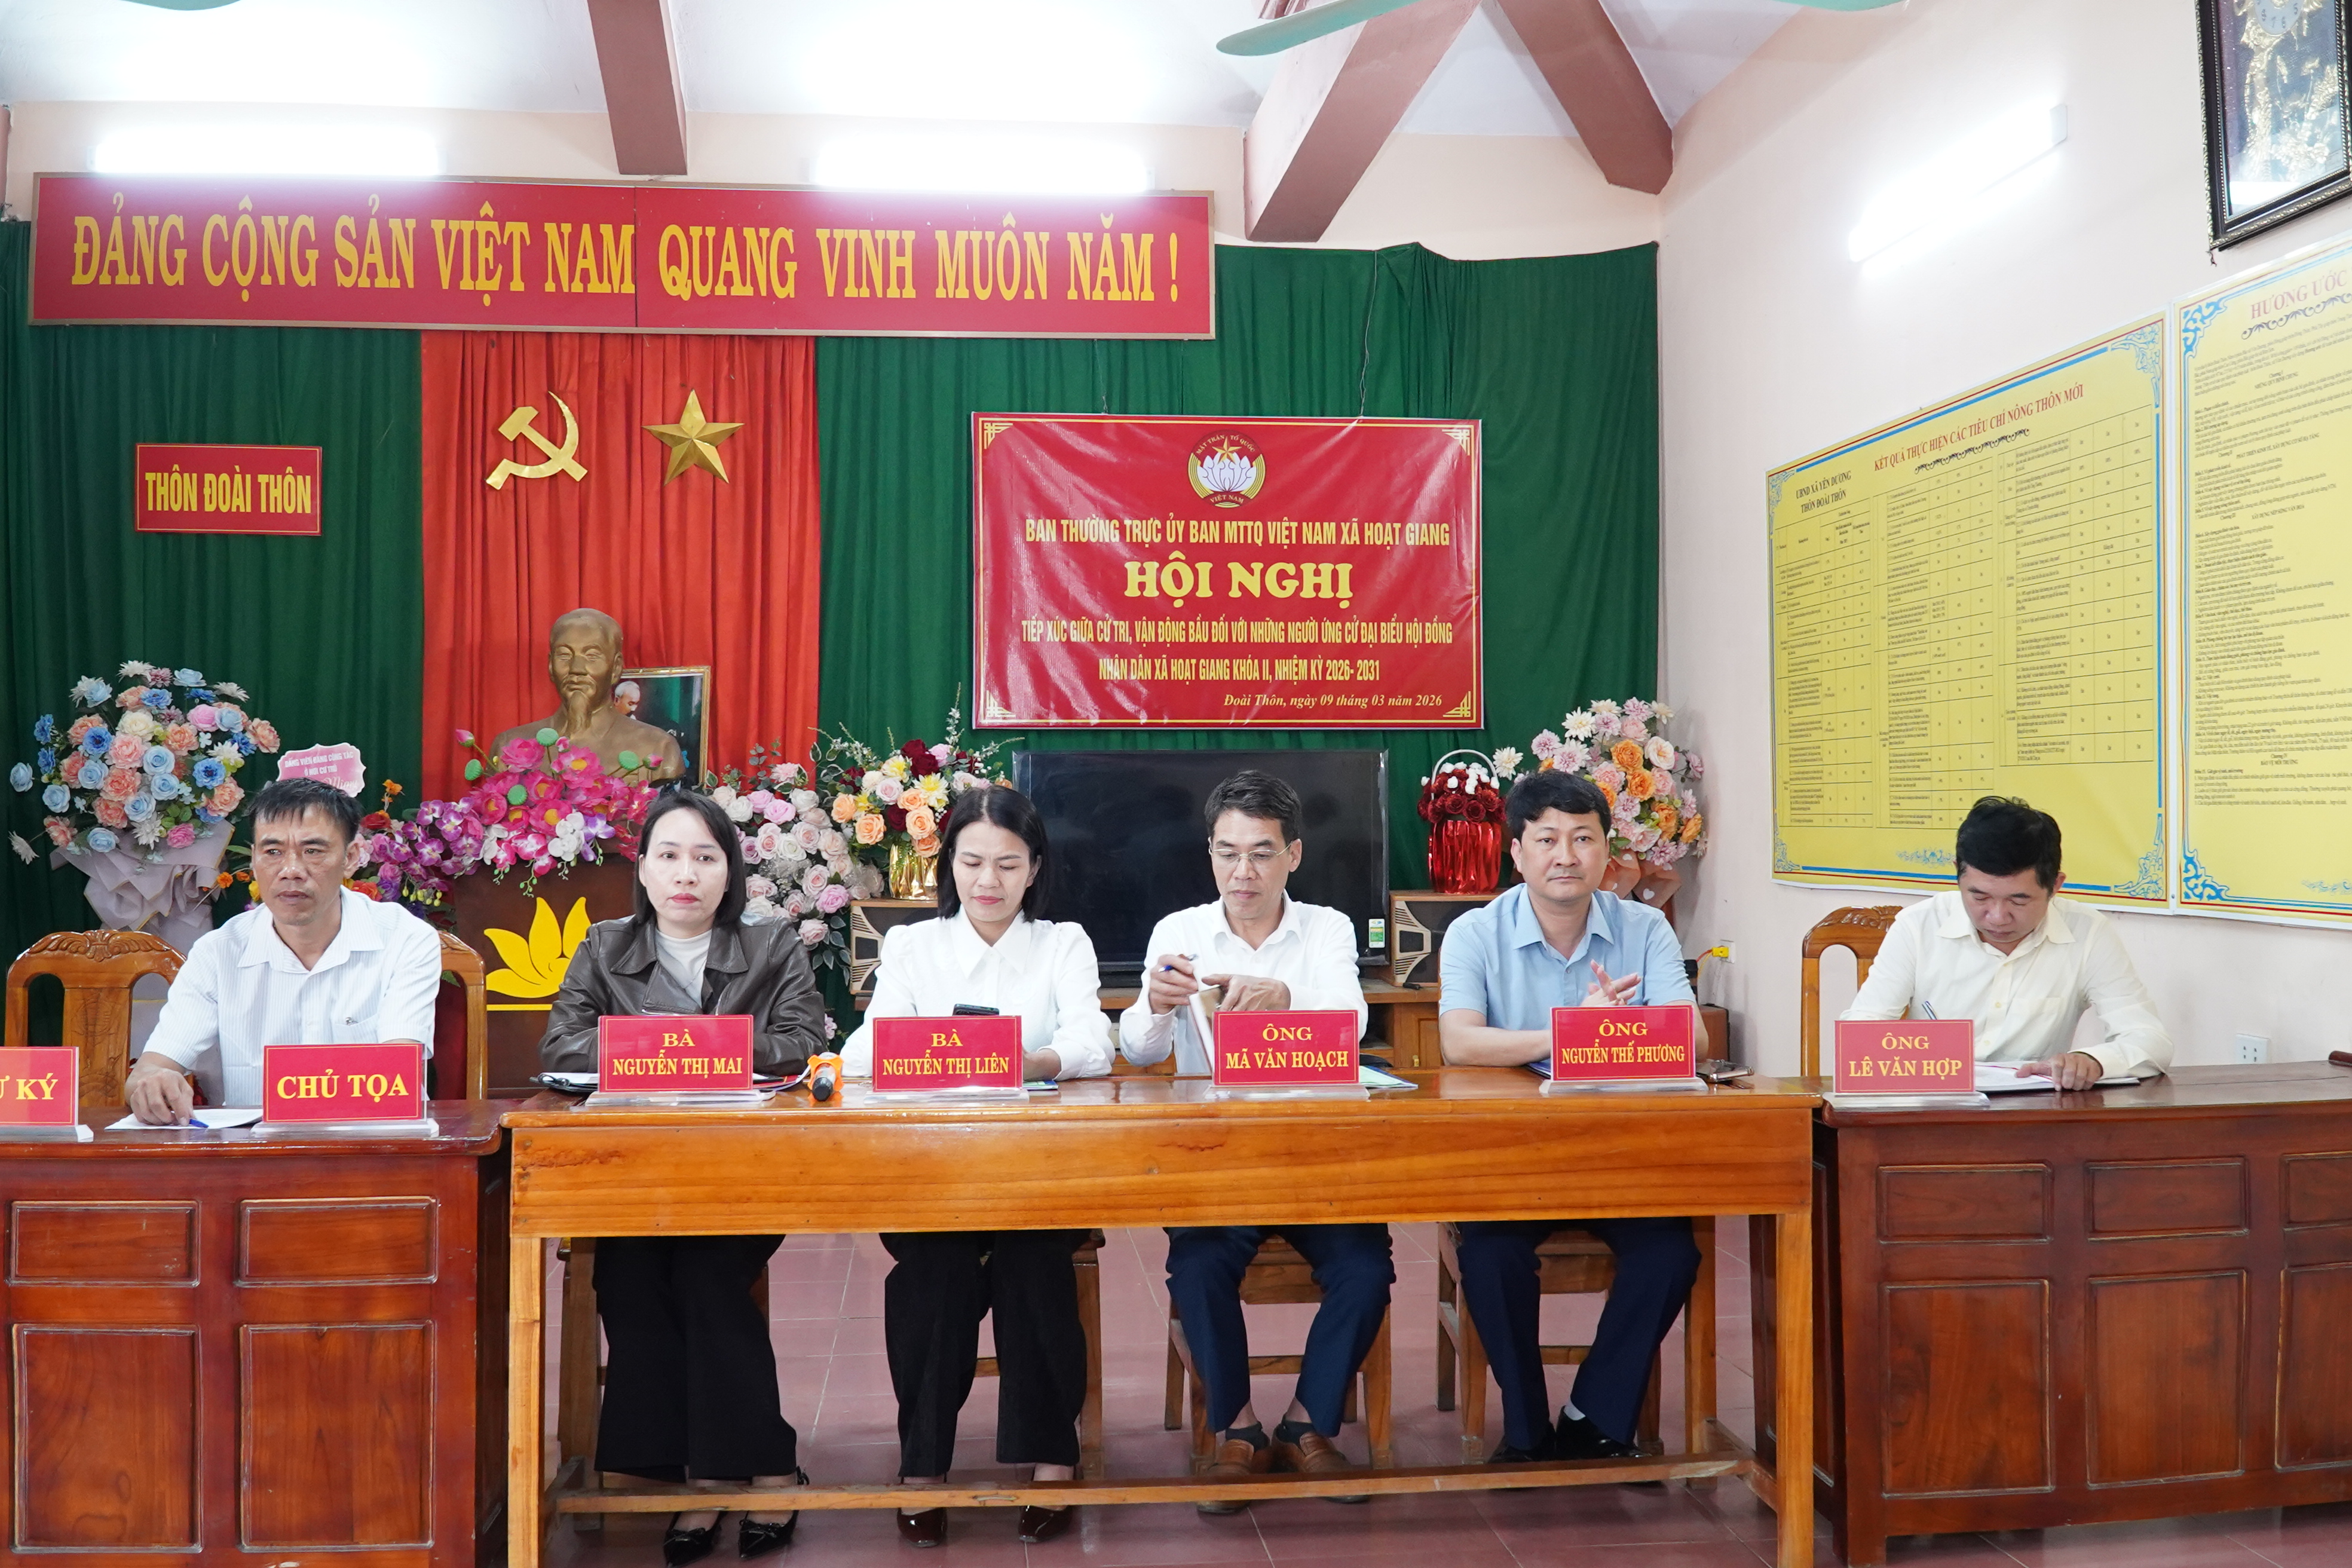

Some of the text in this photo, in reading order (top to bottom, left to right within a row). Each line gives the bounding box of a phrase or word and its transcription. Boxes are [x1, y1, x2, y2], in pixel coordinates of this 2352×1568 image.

[72, 191, 1179, 307] ĐẢNG CỘNG SẢN VIỆT NAM QUANG VINH MUÔN NĂM !
[1875, 382, 2084, 471] KẾT QUẢ THỰC HIỆN CÁC TIÊU CHÍ NÔNG THÔN MỚI
[145, 464, 311, 513] THÔN ĐOÀI THÔN
[1209, 494, 1244, 504] VIỆT NAM
[1026, 512, 1450, 550] BAN THƯỜNG TRỰC ỦY BAN MTTQ VIỆT NAM XÃ HOẠT GIANG
[1124, 550, 1353, 609] HỘI NGHỊ
[1022, 613, 1453, 648] TIẾP XÚC GIỮA CỬ TRI, VẬN ĐỘNG BẦU ĐỐI VỚI NHỮNG NGƯỜI ỨNG CỬ ĐẠI BIỂU HỘI ĐỒNG
[1099, 654, 1128, 680] NHÂN
[1131, 654, 1152, 680] DÂN
[1154, 654, 1168, 680] XÃ
[1171, 659, 1196, 685] HOẠT
[1199, 659, 1230, 681] GIANG
[1233, 654, 1260, 681] KHÓA
[1262, 659, 1272, 684] II,
[1275, 655, 1307, 685] NHIỆM
[1310, 655, 1323, 681] KỲ
[1356, 660, 1380, 681] 2031
[1224, 694, 1443, 709] Đoài Thôn, ngày 09 tháng 03 năm 2026
[662, 1028, 696, 1047] BÀ
[930, 1028, 963, 1047] BÀ
[1262, 1023, 1313, 1041] ÔNG
[1598, 1019, 1648, 1036] ÔNG
[1882, 1032, 1930, 1050] ÔNG
[612, 1049, 743, 1079] NGUYỄN THỊ MAI
[883, 1049, 1009, 1079] NGUYỄN THỊ LIÊN
[1226, 1048, 1349, 1072] MÃ VĂN HOẠCH
[1561, 1039, 1685, 1064] NGUYỄN THẾ PHƯƠNG
[1849, 1056, 1962, 1080] LÊ VĂN HỢP
[16, 1073, 58, 1100] KÝ
[277, 1069, 410, 1103] CHỦ TỌA
